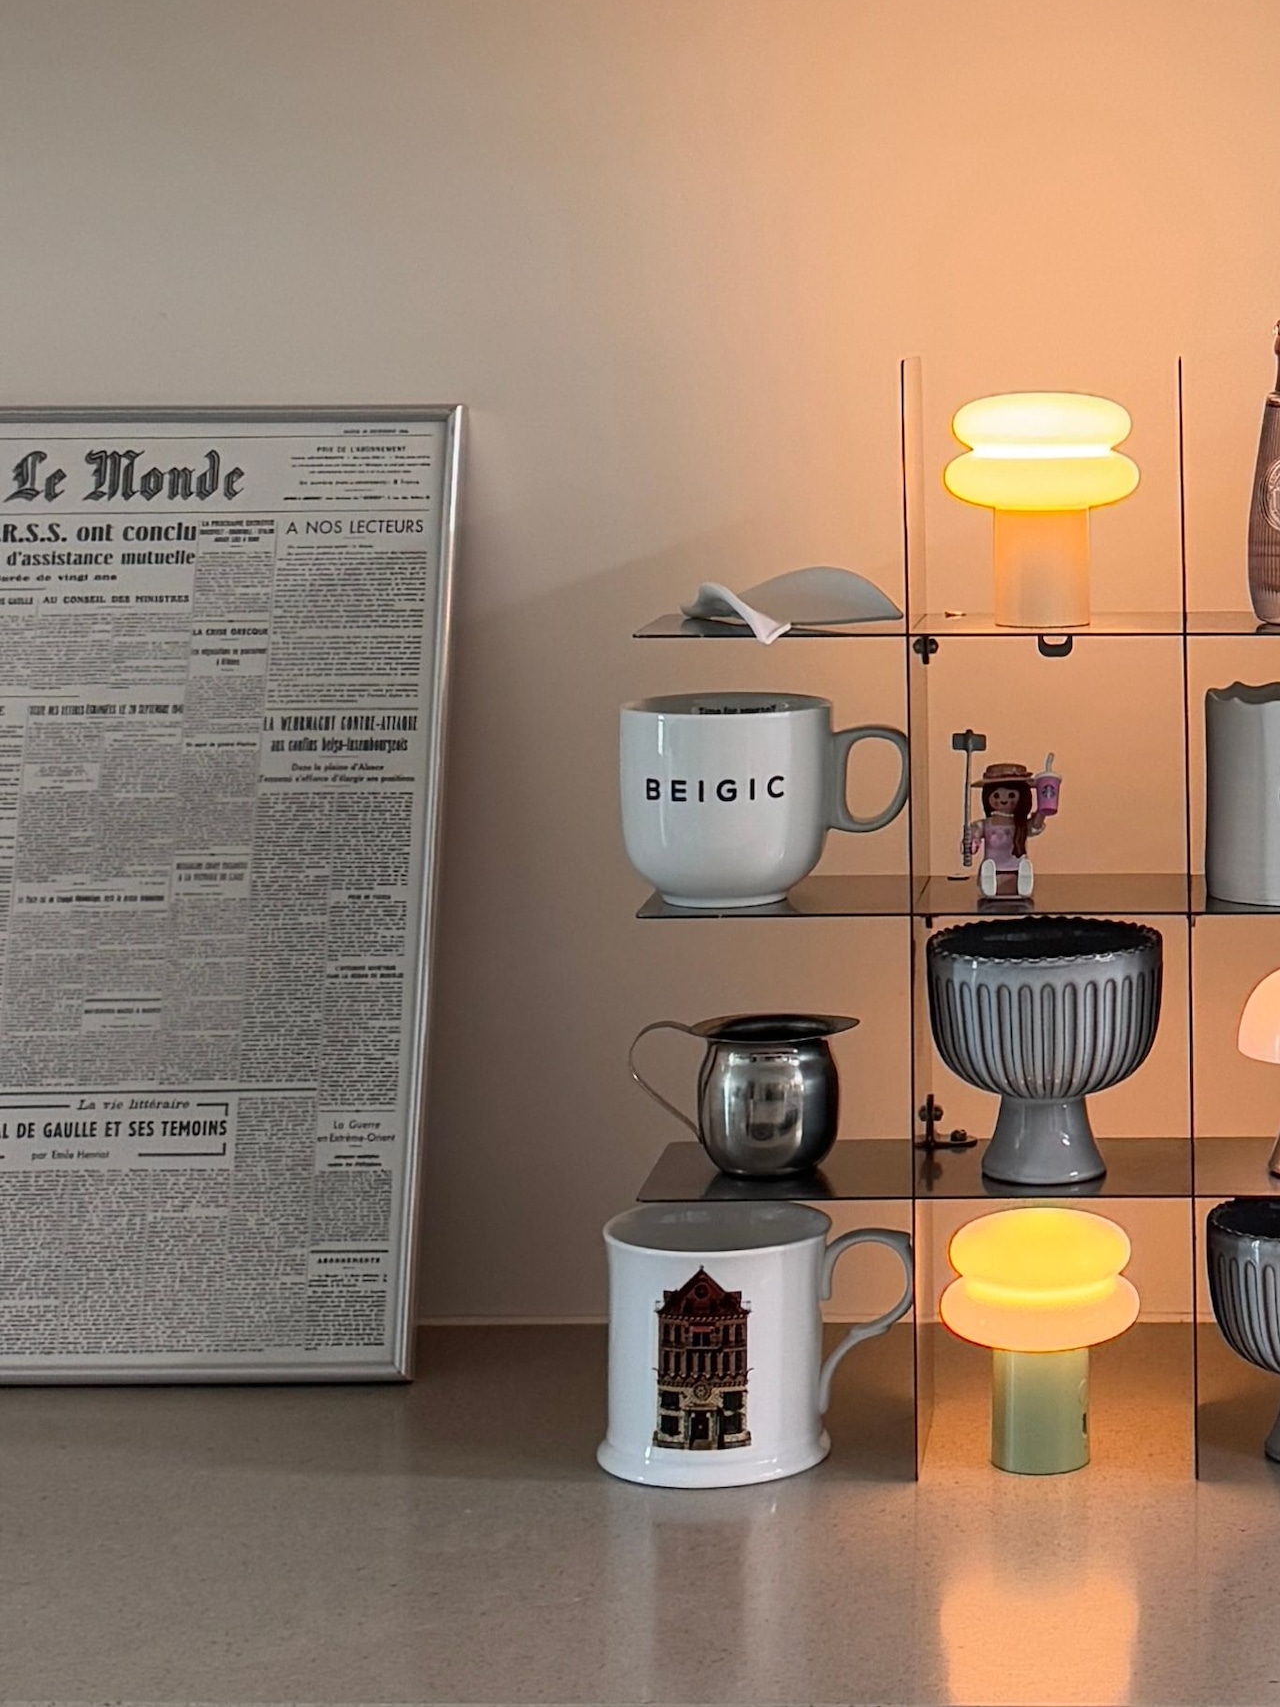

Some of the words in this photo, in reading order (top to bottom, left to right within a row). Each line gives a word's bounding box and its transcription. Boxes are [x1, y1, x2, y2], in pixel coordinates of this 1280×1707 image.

[3, 450, 67, 502] Le
[82, 449, 245, 501] Monde
[76, 524, 114, 542] ont
[122, 522, 197, 541] conclu
[286, 521, 298, 535] A
[306, 520, 342, 534] NOS
[350, 519, 424, 534] LECTEURS
[7, 550, 113, 566] d'assistance
[121, 550, 196, 565] mutuelle
[42, 596, 57, 604] AU
[63, 596, 106, 604] CONSEIL
[263, 716, 275, 731] LA
[646, 775, 785, 802] BEIGIC
[77, 1099, 96, 1110] La
[103, 1099, 123, 1110] vie
[128, 1098, 190, 1110] littéraire
[17, 1122, 36, 1139] DE
[43, 1121, 98, 1139] GAULLE
[105, 1121, 122, 1137] ET
[128, 1120, 154, 1137] SES
[161, 1120, 228, 1137] TEMOINS
[333, 1120, 344, 1130] La
[349, 1120, 381, 1130] Guerre
[31, 1151, 47, 1161] par
